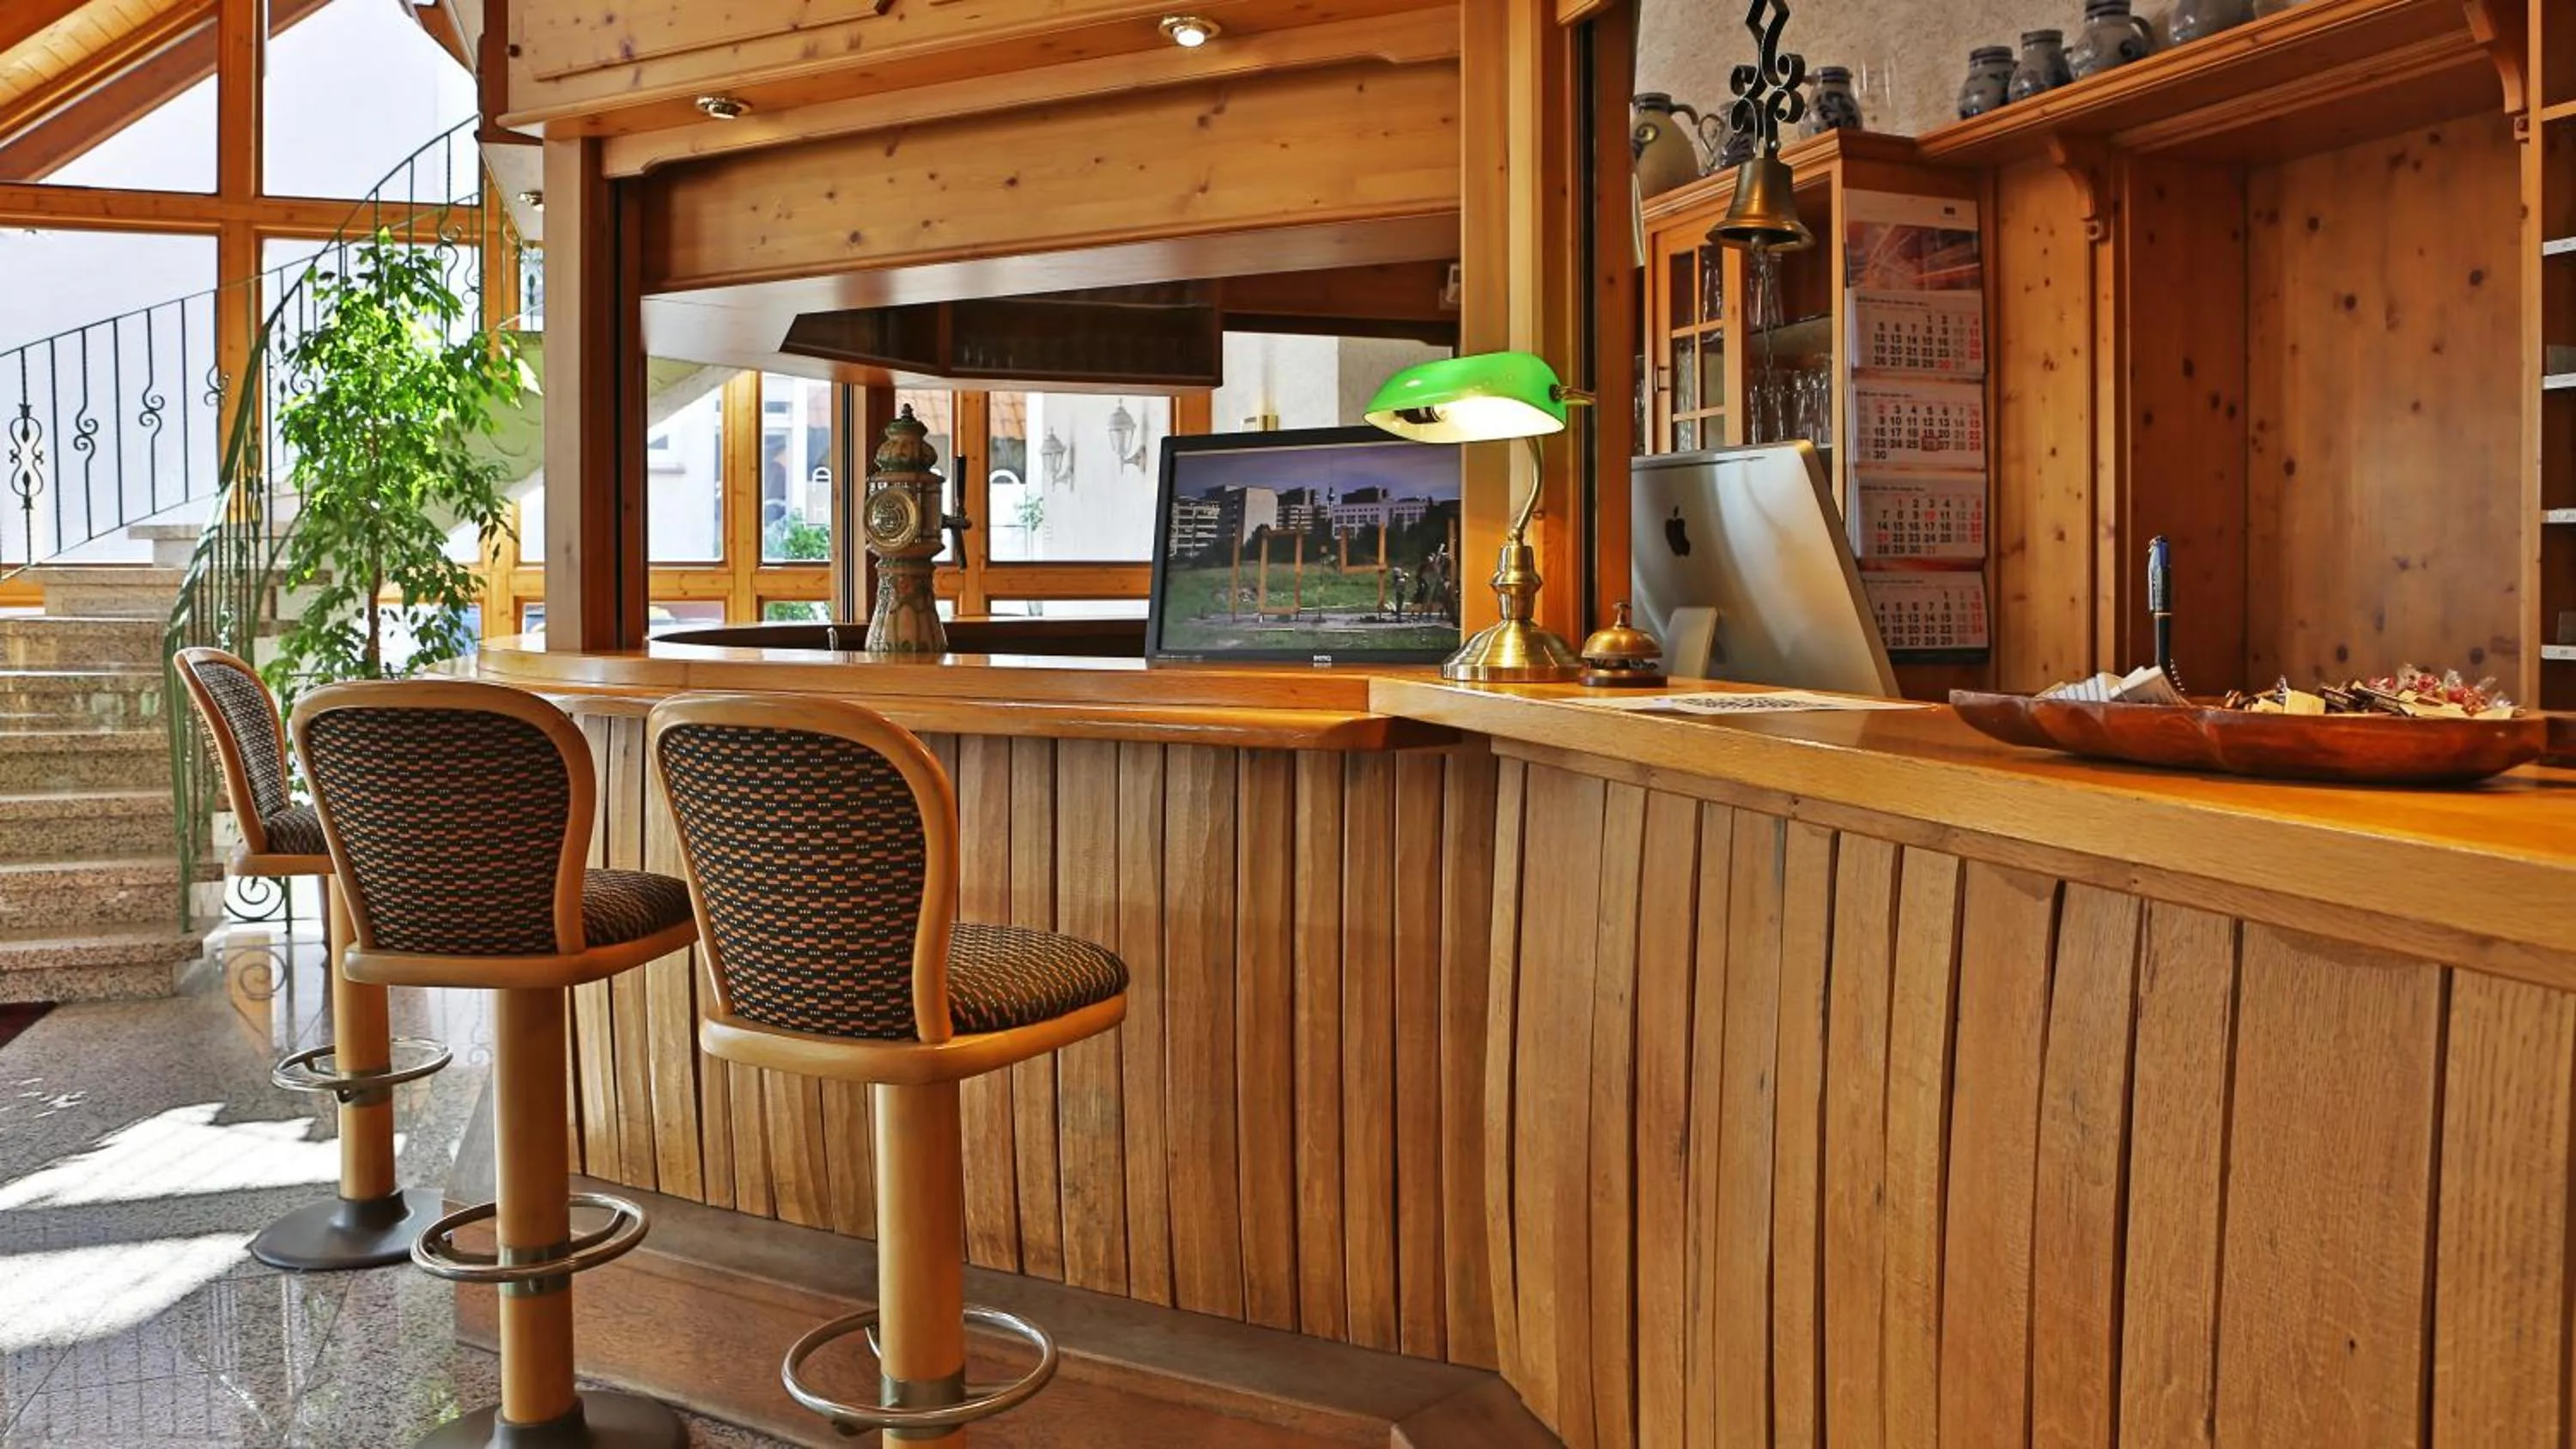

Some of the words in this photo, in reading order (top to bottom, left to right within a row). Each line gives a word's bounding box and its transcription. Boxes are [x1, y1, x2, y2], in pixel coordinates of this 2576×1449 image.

[1941, 316, 1947, 324] 2
[1894, 323, 1901, 332] 6
[1911, 324, 1917, 333] 7
[1926, 325, 1933, 334] 8
[1874, 333, 1886, 343] 12
[1891, 334, 1902, 343] 13
[1907, 336, 1917, 344] 14
[1922, 336, 1933, 345] 15
[1937, 337, 1948, 346] 16
[1874, 345, 1886, 354] 19
[1889, 345, 1902, 355] 20
[1906, 347, 1917, 355] 21
[1922, 348, 1933, 356] 22
[1937, 349, 1949, 357] 23
[1874, 356, 1886, 365] 26
[1891, 357, 1902, 366] 27
[1906, 358, 1918, 367] 28
[1922, 359, 1935, 367] 29
[1894, 404, 1901, 414] 3
[1911, 405, 1917, 414] 4
[1926, 405, 1933, 415] 5
[1942, 406, 1948, 415] 6
[1878, 415, 1886, 425] 9
[1891, 416, 1902, 426] 10
[1907, 417, 1917, 426] 11
[1923, 417, 1934, 426] 12
[1939, 418, 1950, 427] 13
[1874, 427, 1886, 436] 16
[1891, 427, 1902, 436] 17
[1907, 428, 1918, 437] 18
[1923, 429, 1934, 438] 19
[1938, 429, 1949, 438] 20
[1954, 430, 1965, 439] 21
[1970, 431, 1980, 440] 22
[1874, 440, 1886, 448] 23
[1890, 440, 1903, 448] 24
[1906, 440, 1918, 448] 25
[1938, 441, 1949, 450] 27
[1874, 451, 1886, 459] 30
[1898, 498, 1902, 508] 1
[1913, 499, 1918, 508] 2
[1929, 499, 1935, 508] 3
[1944, 499, 1951, 507] 4
[1881, 510, 1888, 518] 7
[1913, 510, 1919, 519] 9
[1941, 511, 1950, 519] 11
[1877, 522, 1888, 531] 14
[1893, 522, 1904, 530] 15
[1909, 522, 1919, 530] 16
[1925, 522, 1935, 530] 17
[1941, 522, 1951, 530] 18
[1893, 533, 1905, 543] 22
[1909, 533, 1920, 543] 23
[1924, 534, 1936, 543] 24
[1941, 534, 1951, 543] 25
[1877, 544, 1889, 554] 28
[1893, 545, 1905, 554] 29
[1910, 545, 1921, 554] 30
[1944, 591, 1948, 599] 1
[1880, 602, 1886, 611] 4
[1896, 602, 1902, 611] 5
[1911, 602, 1918, 610] 6
[1929, 602, 1935, 610] 7
[1892, 614, 1903, 622] 12
[1908, 614, 1919, 622] 13
[1925, 613, 1935, 622] 14
[1908, 625, 1920, 634] 20
[1924, 625, 1935, 634] 21
[1940, 625, 1952, 634] 22
[1909, 637, 1920, 646] 27
[1925, 637, 1936, 646] 28
